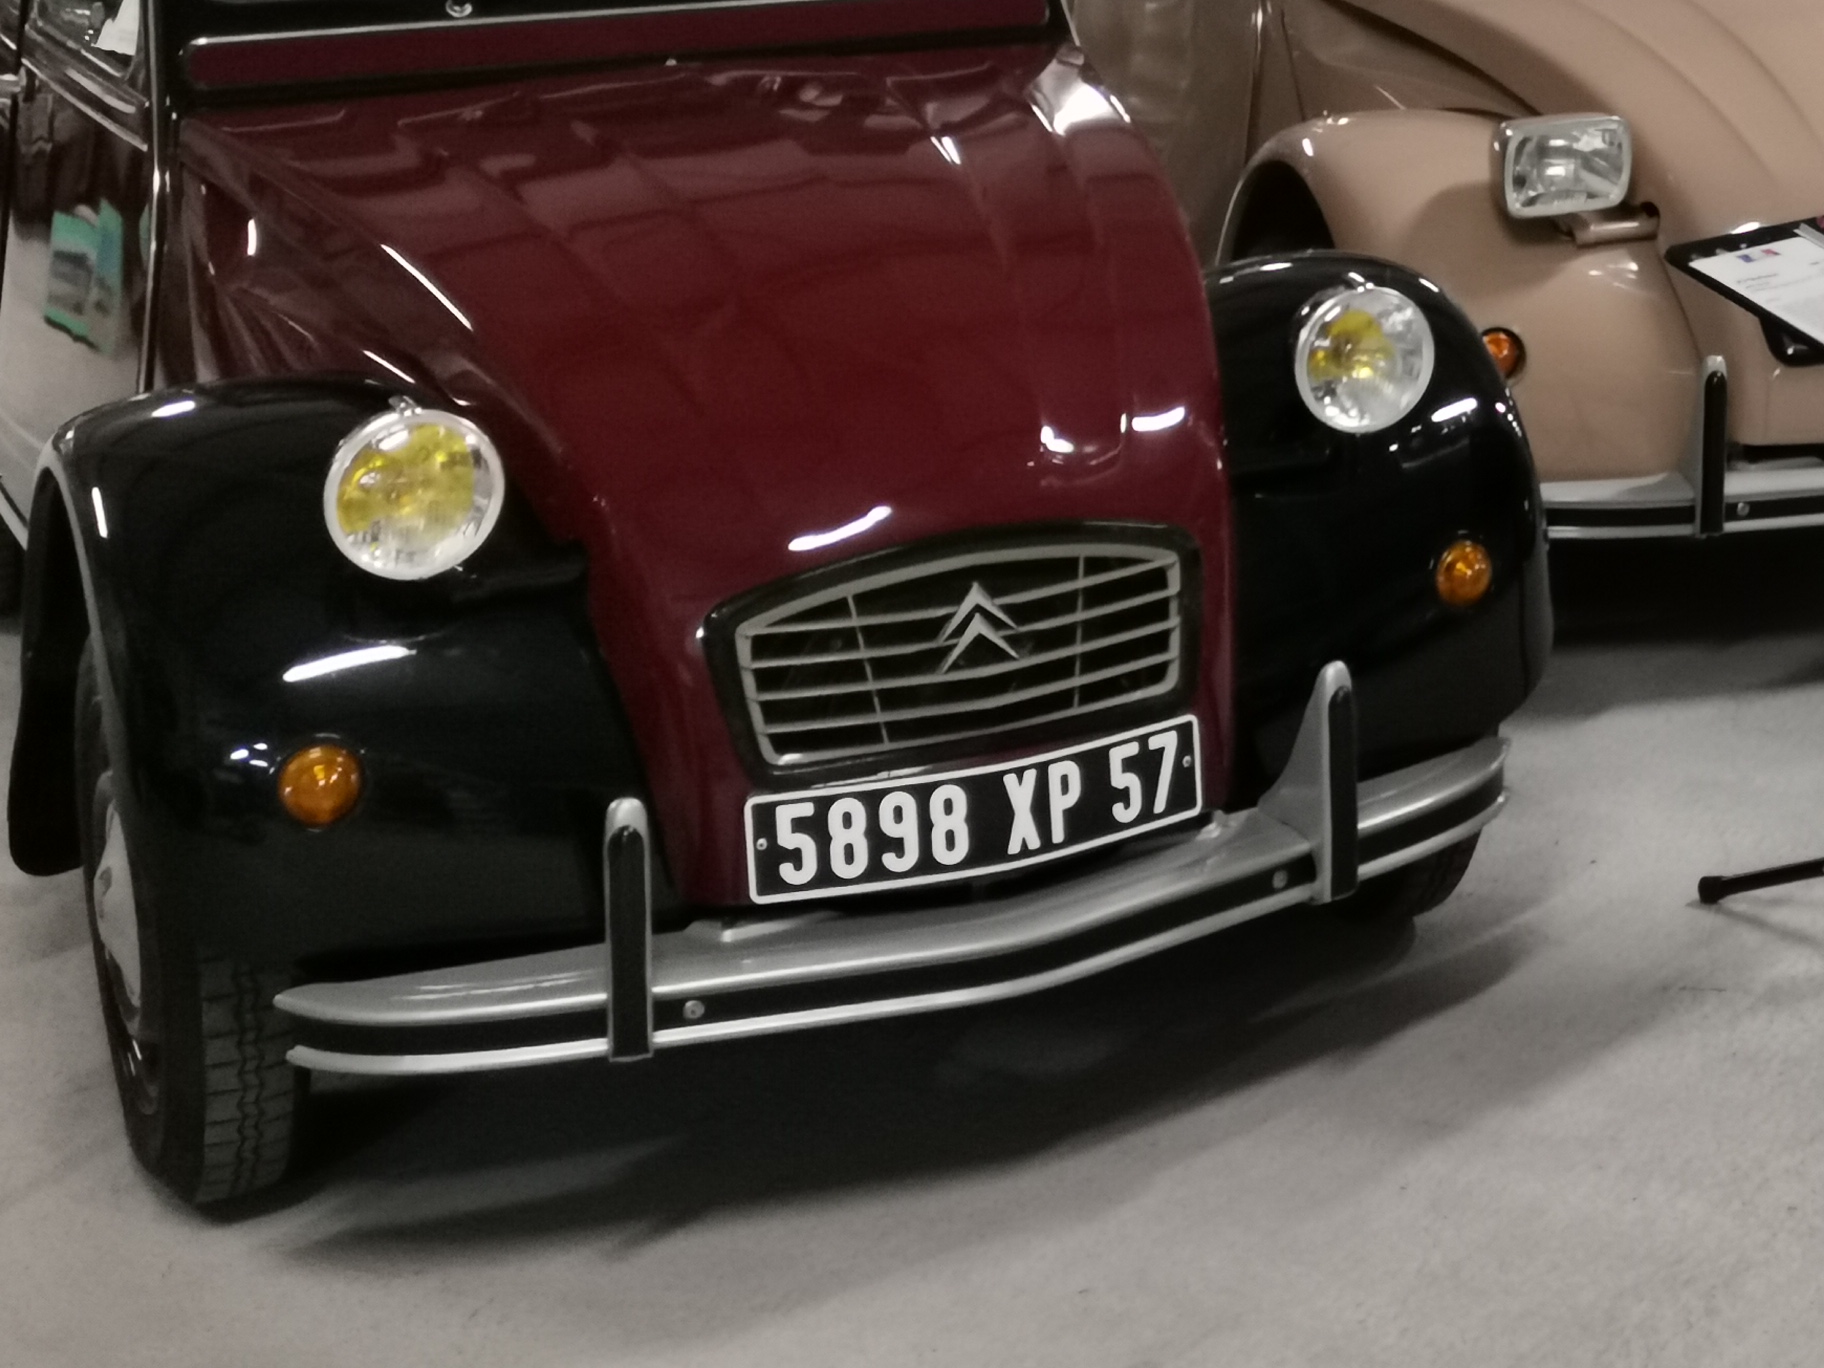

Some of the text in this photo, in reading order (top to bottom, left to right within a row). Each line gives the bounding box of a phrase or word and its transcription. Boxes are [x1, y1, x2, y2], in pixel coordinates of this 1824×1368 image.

[775, 730, 1179, 886] 5898 XP 57
